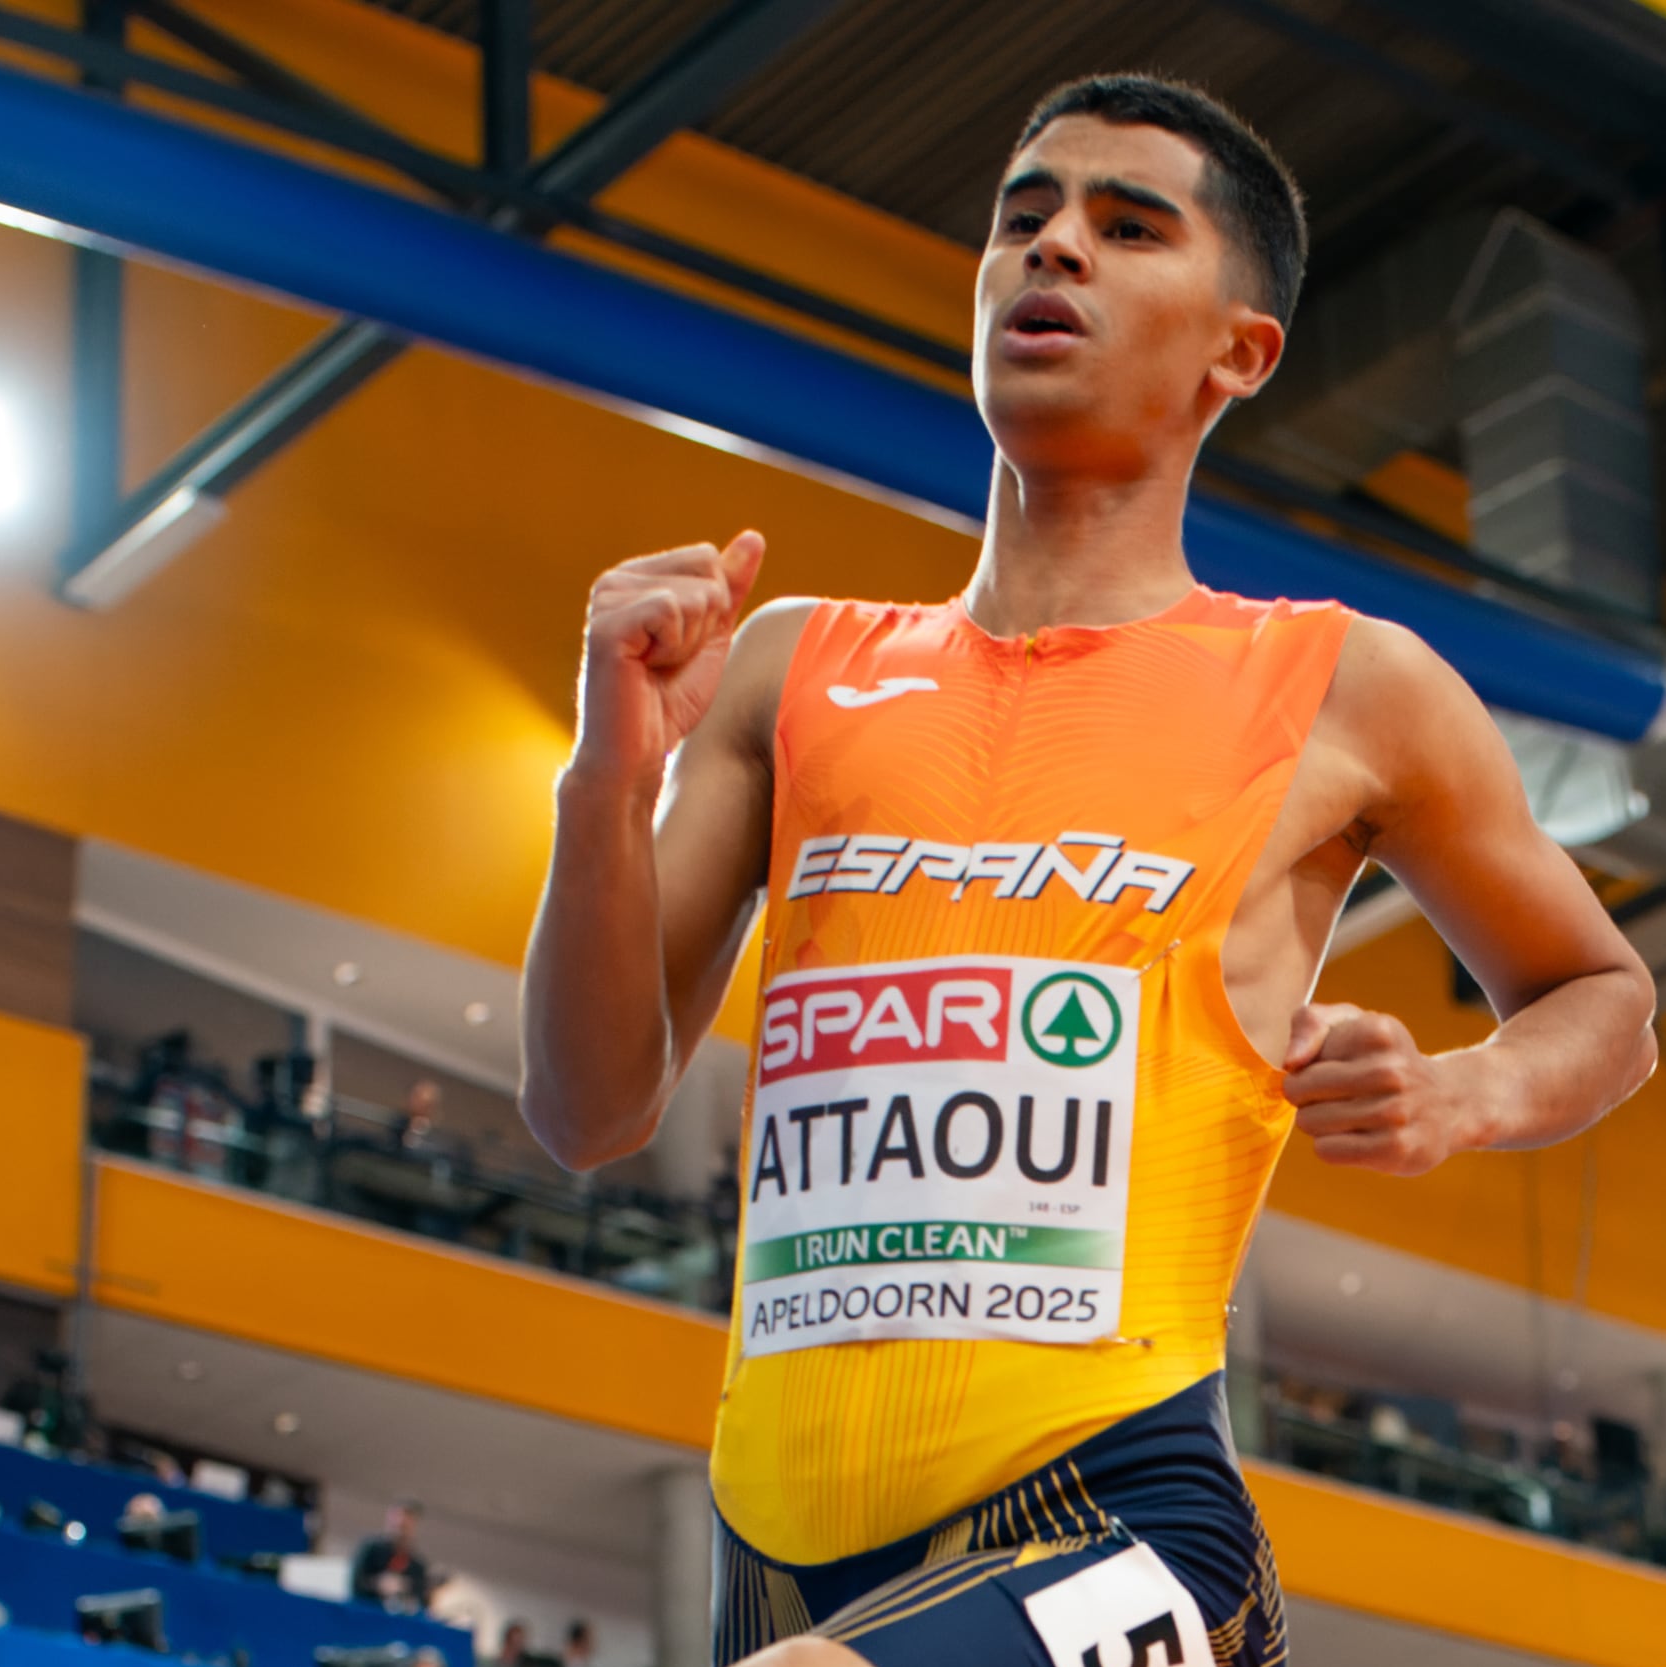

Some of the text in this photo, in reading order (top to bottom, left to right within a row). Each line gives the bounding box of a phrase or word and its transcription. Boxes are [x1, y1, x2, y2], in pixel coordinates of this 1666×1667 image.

[786, 831, 1196, 914] ESPAÑA
[762, 979, 1001, 1071] SPAR
[751, 1091, 1112, 1203] ATTAOUI
[795, 1238, 802, 1268] I
[808, 1228, 869, 1266] RUN
[751, 1283, 1099, 1338] APELDOORN 2025
